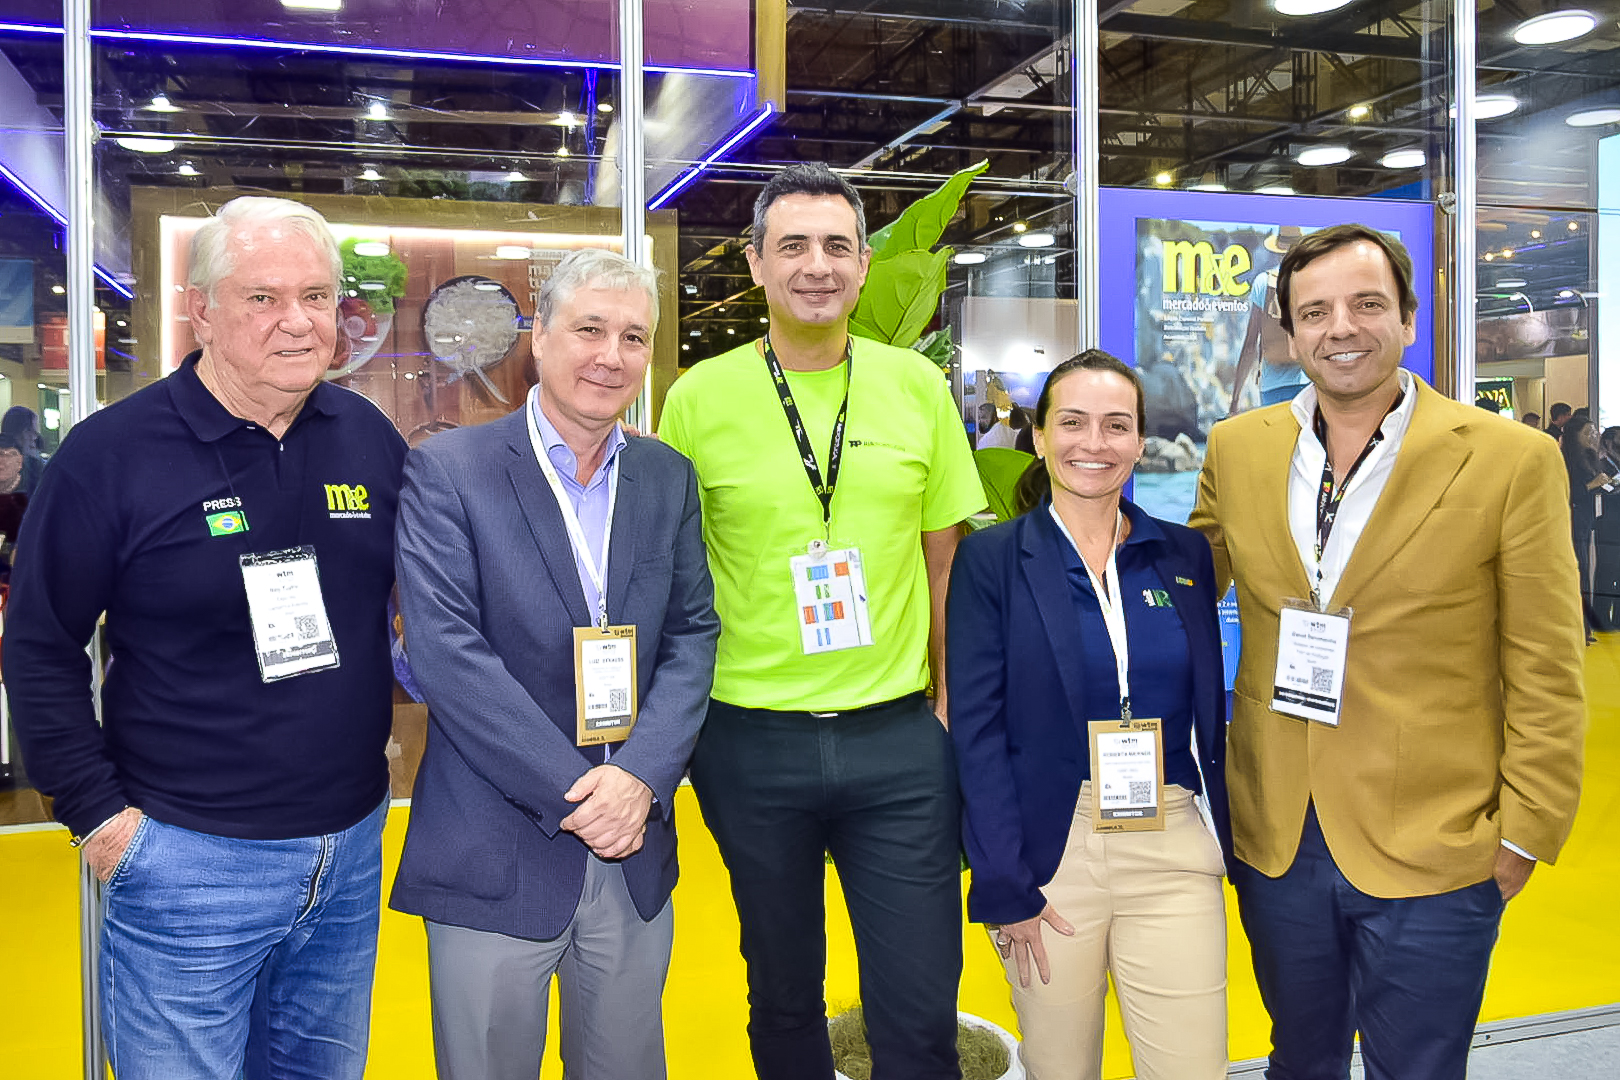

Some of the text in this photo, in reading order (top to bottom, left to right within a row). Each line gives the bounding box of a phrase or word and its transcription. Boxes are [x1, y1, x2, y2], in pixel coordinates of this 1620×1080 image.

[1162, 240, 1252, 297] m&e
[1162, 297, 1249, 312] mercado&eventos
[202, 496, 242, 511] PRESS
[324, 483, 370, 511] m&e
